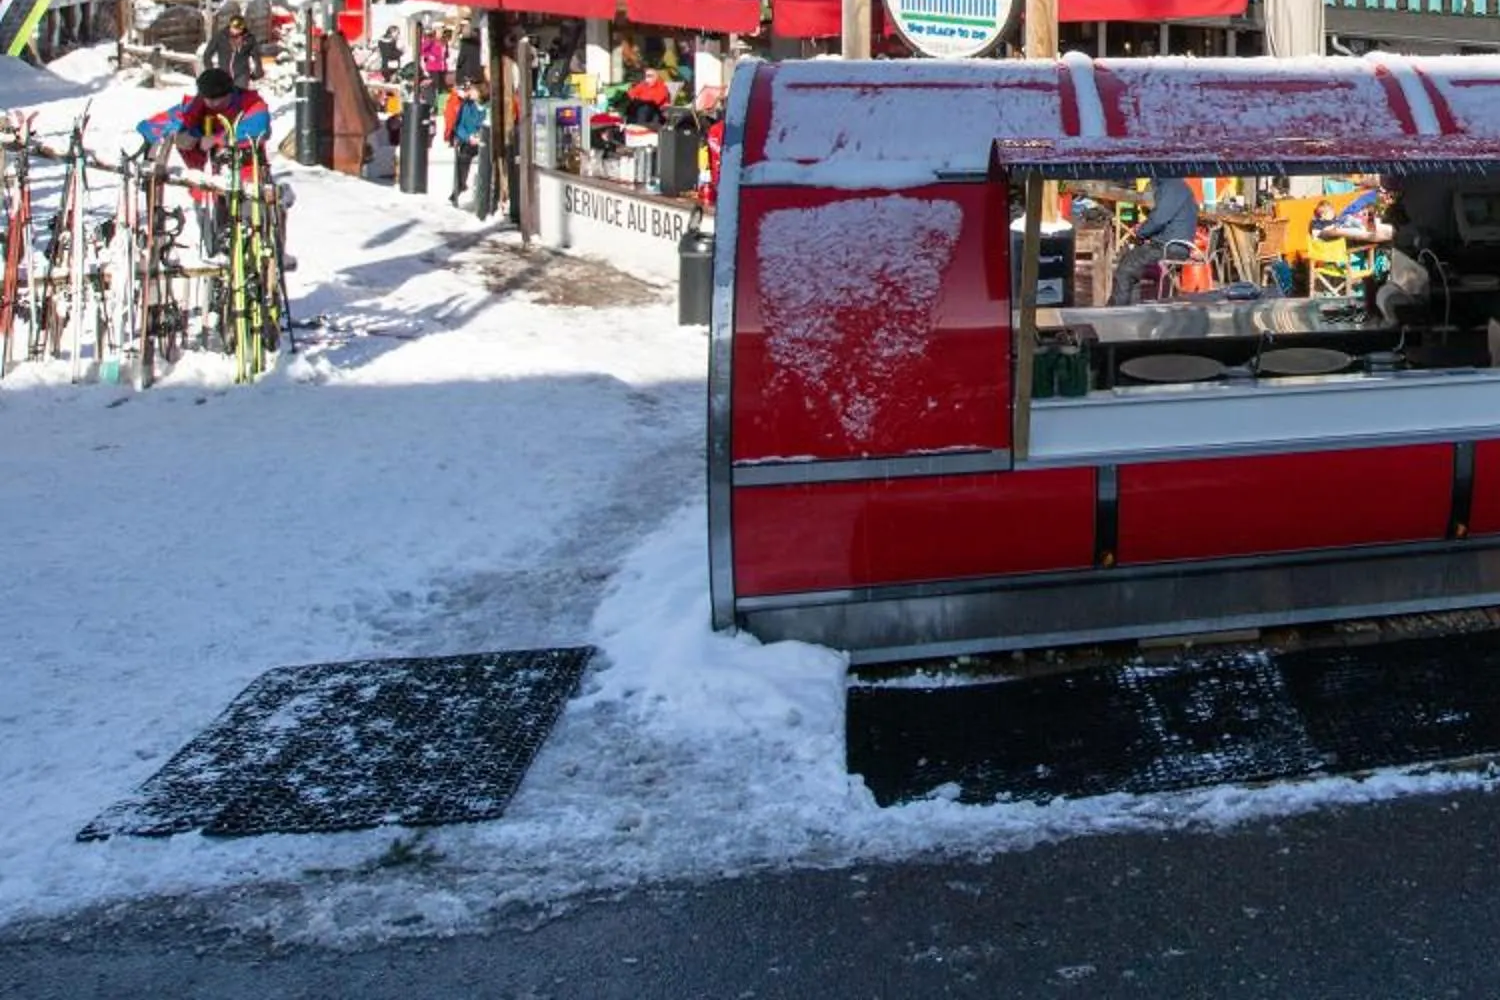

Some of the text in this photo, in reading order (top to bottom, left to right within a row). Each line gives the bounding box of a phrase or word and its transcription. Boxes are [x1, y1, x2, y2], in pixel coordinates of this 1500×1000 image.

[565, 184, 684, 242] SERVICE AU BAR
